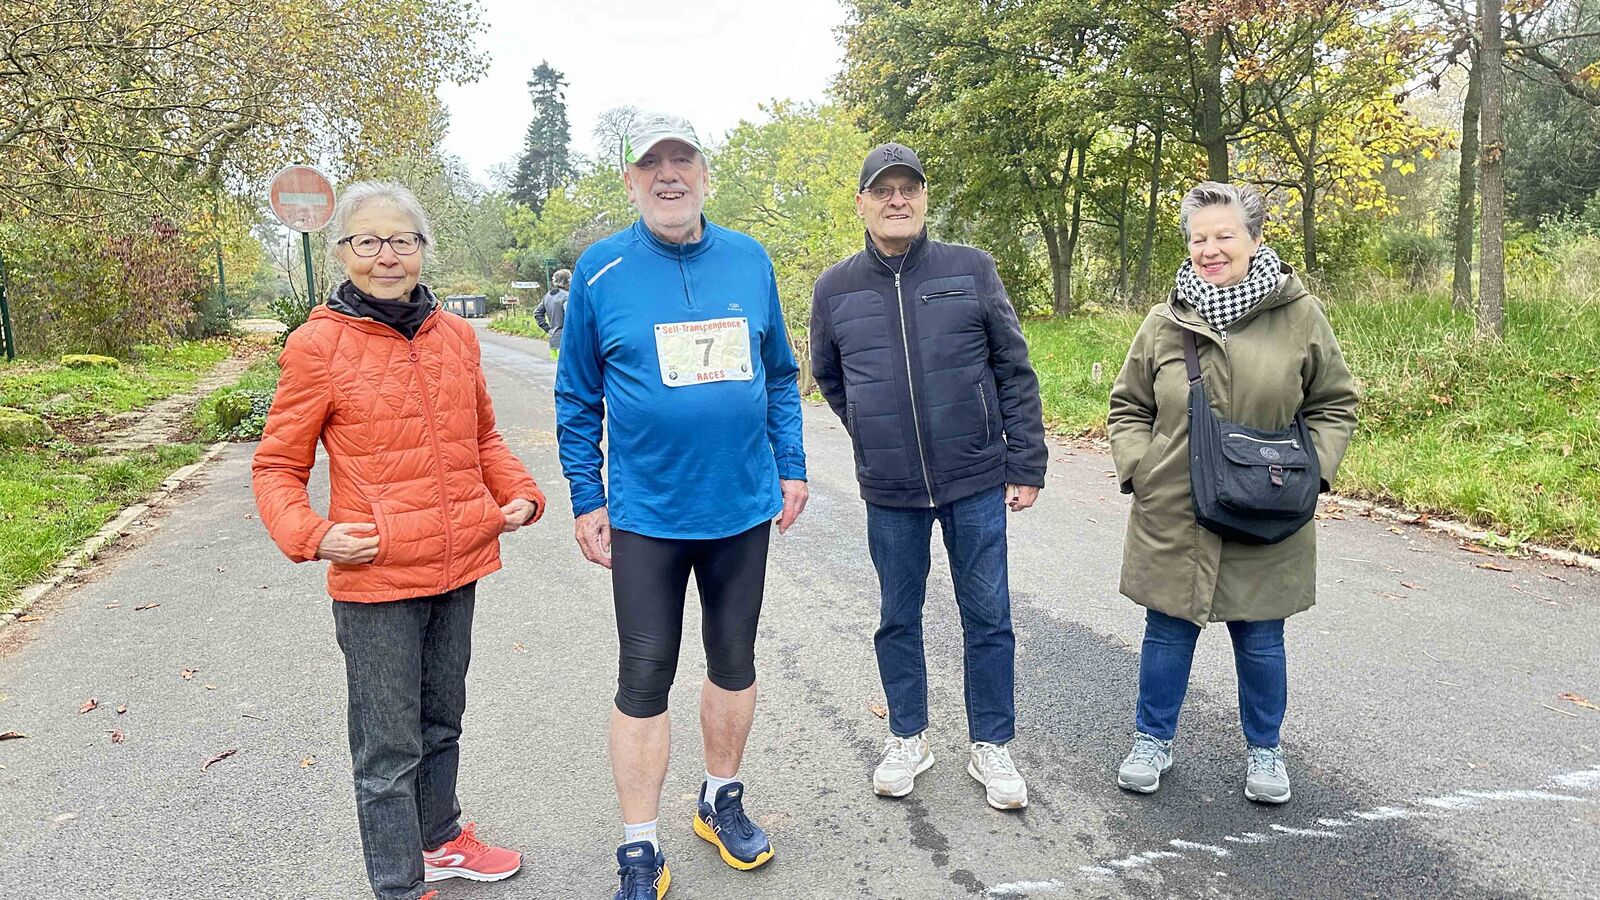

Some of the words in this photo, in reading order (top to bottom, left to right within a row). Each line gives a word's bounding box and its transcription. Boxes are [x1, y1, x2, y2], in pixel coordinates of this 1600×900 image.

[662, 319, 741, 334] Self-Transcendence
[695, 337, 715, 367] 7
[697, 370, 725, 382] RACES
